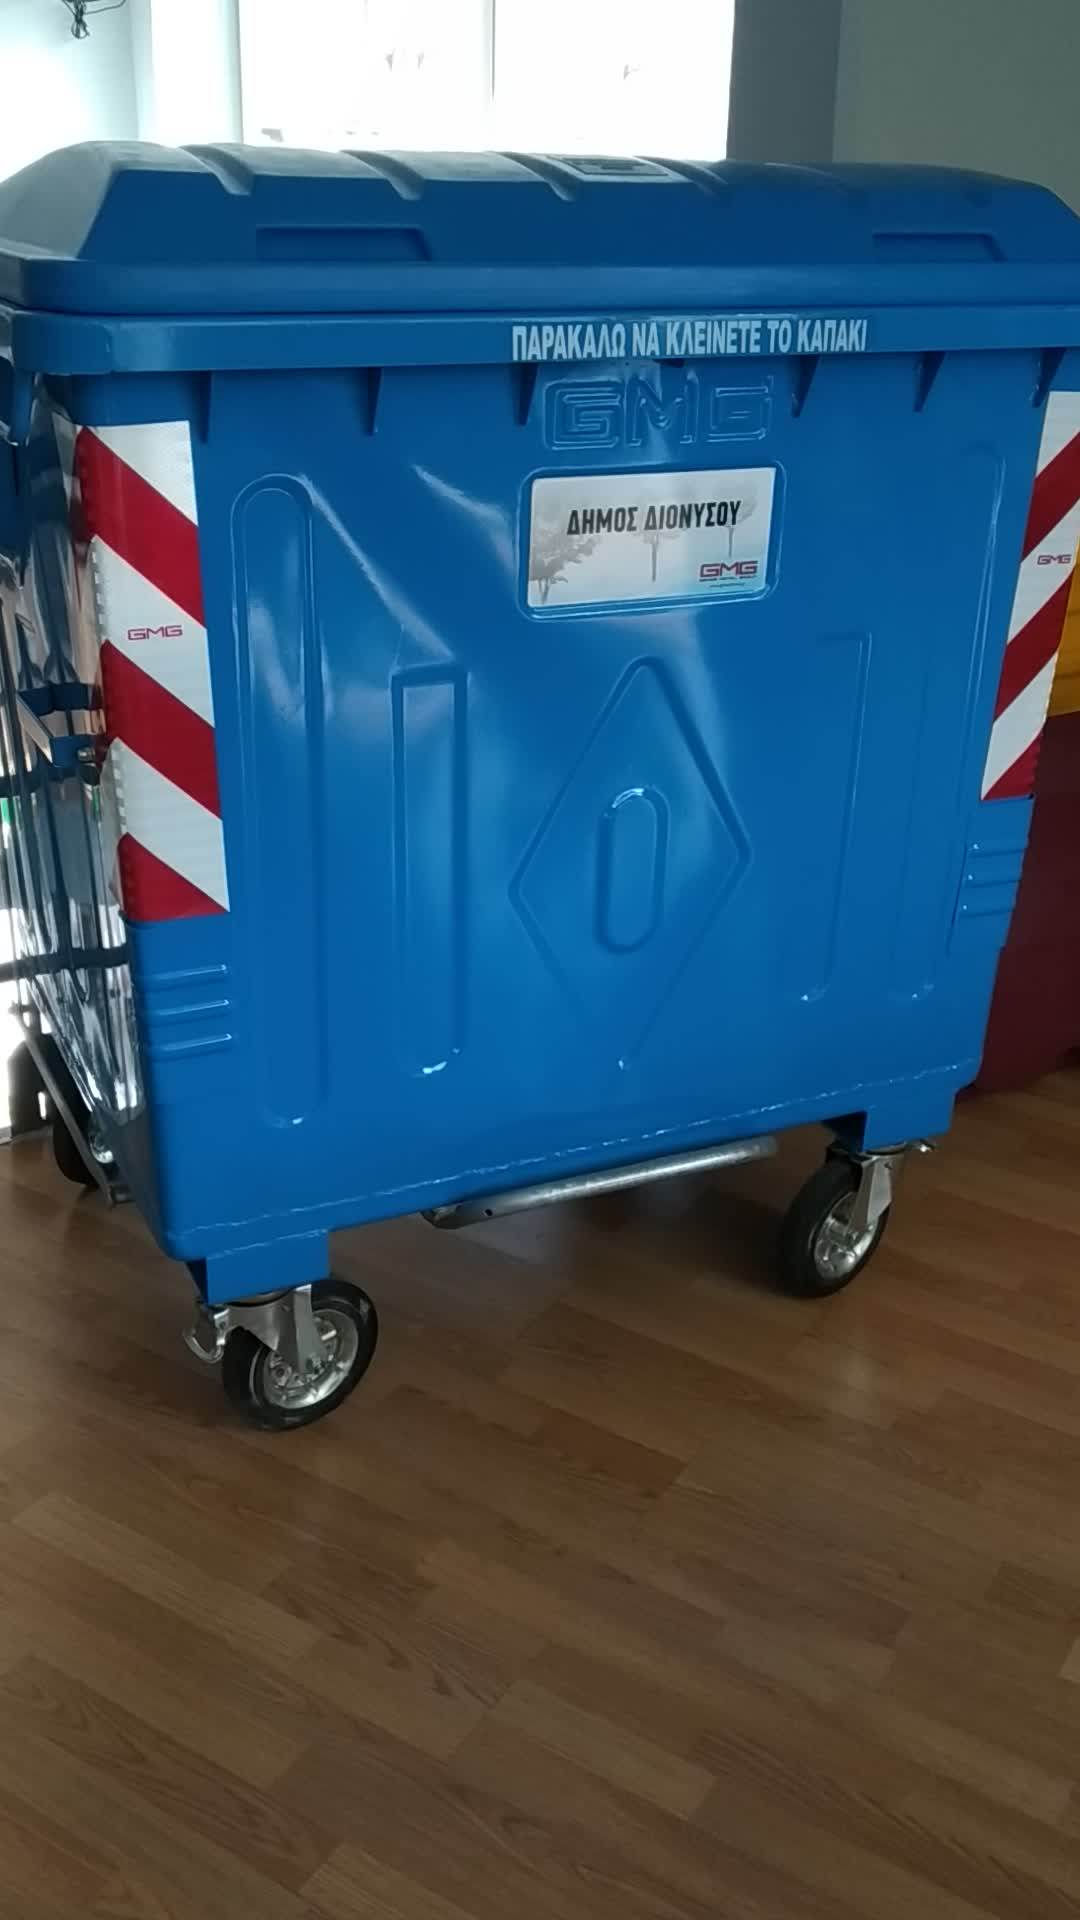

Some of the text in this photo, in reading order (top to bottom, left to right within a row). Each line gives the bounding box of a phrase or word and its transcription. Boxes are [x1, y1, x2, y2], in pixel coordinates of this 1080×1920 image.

[512, 319, 868, 361] ΠΑΡΑΚΑΛΩ ΝΑ ΚΛΕΙΝΕΤΕ ΤΟ ΚΑΠΑΚΙ
[542, 370, 775, 450] GMG
[566, 499, 742, 536] ΔΗΜΟΣ ΔΙΟΝΥΣΟΥ
[700, 560, 758, 578] GMG
[127, 624, 183, 641] GMG
